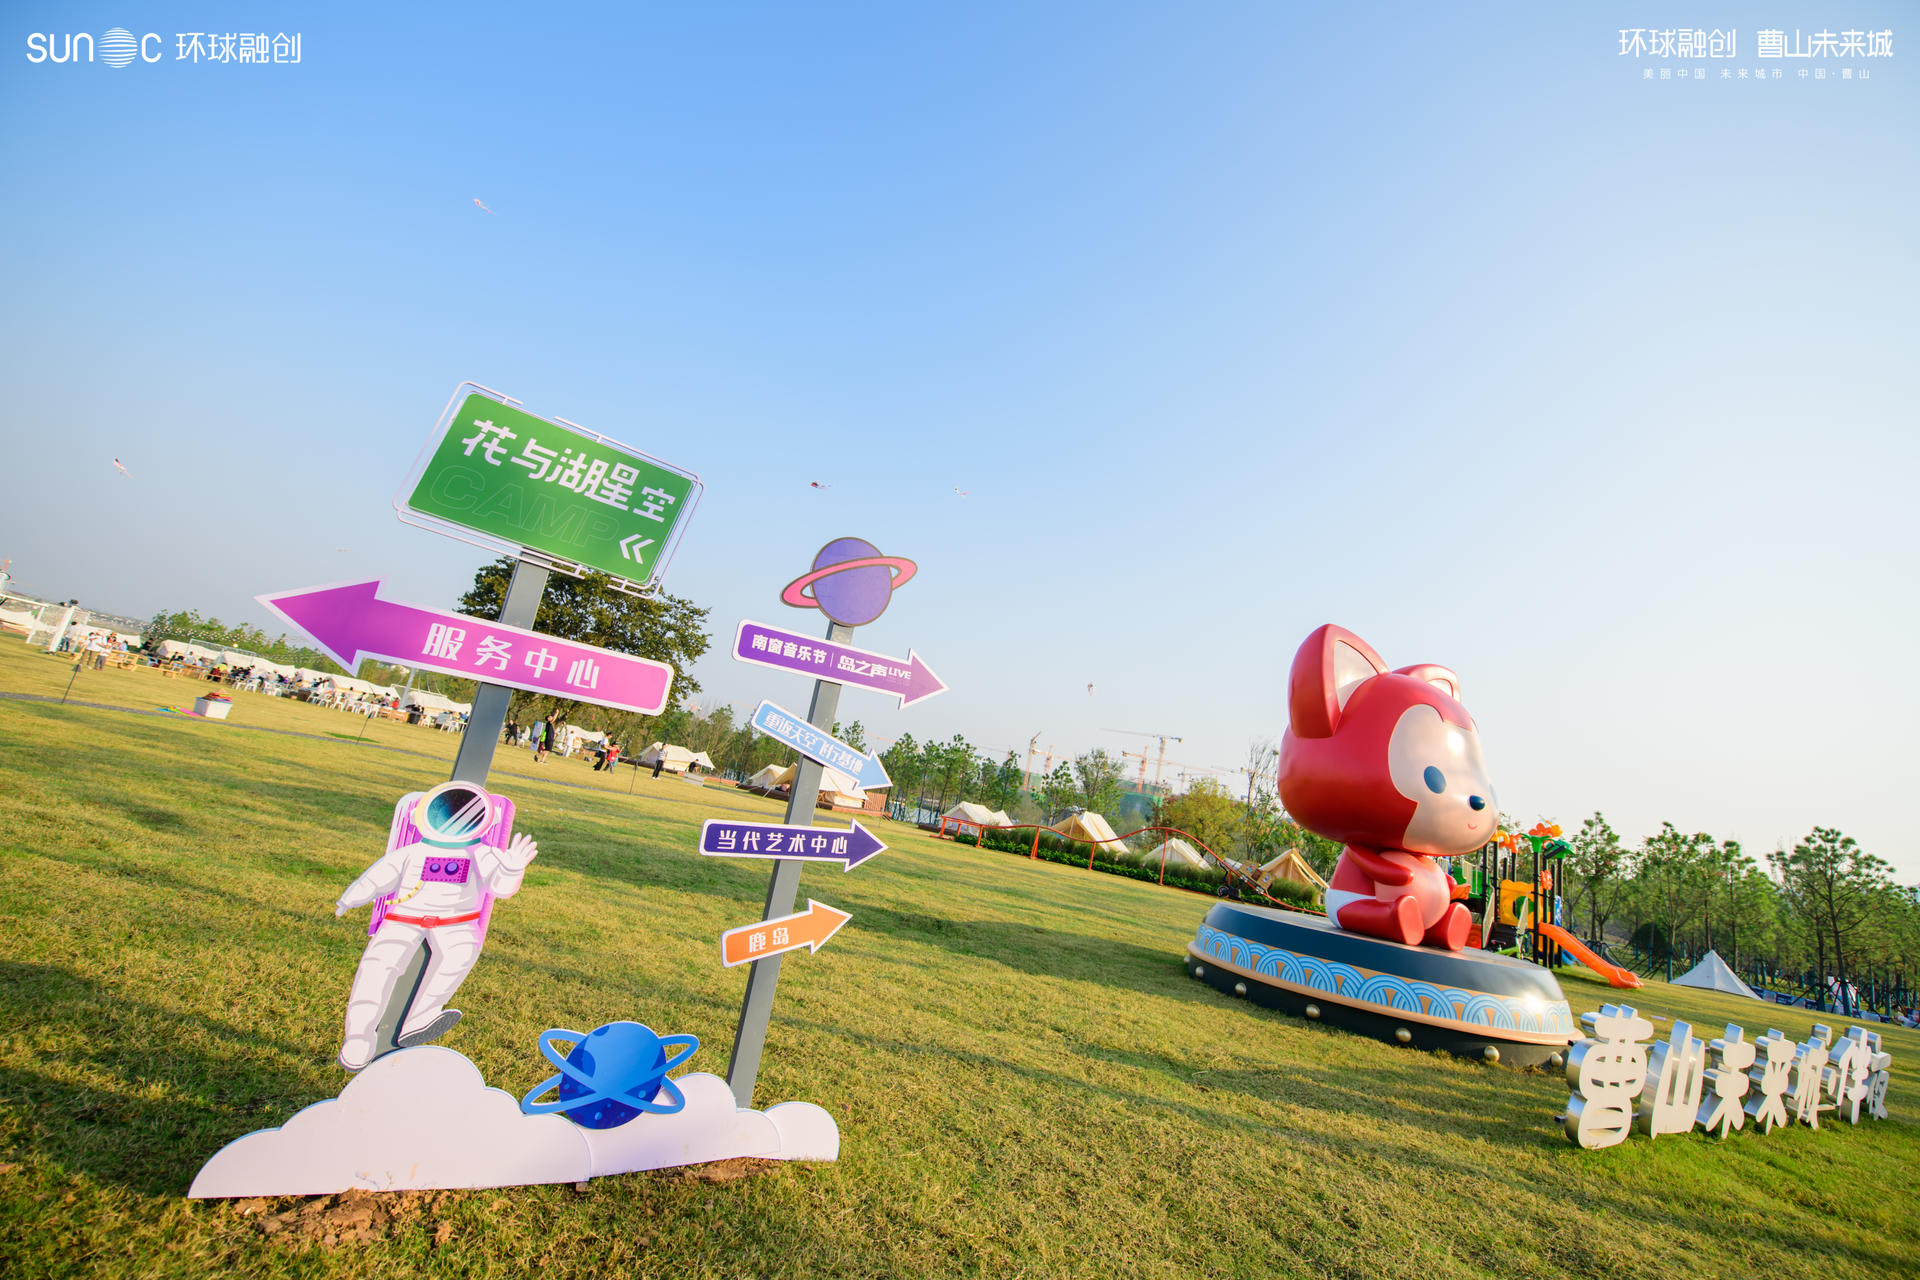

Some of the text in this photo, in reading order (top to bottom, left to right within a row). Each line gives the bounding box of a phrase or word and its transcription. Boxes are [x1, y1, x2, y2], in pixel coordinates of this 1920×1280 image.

[461, 419, 676, 523] 花与湖星空
[430, 465, 620, 547] CAMP
[421, 622, 600, 689] 服务中心
[717, 830, 848, 855] 当代艺术中心
[749, 927, 790, 953] 鹿岛
